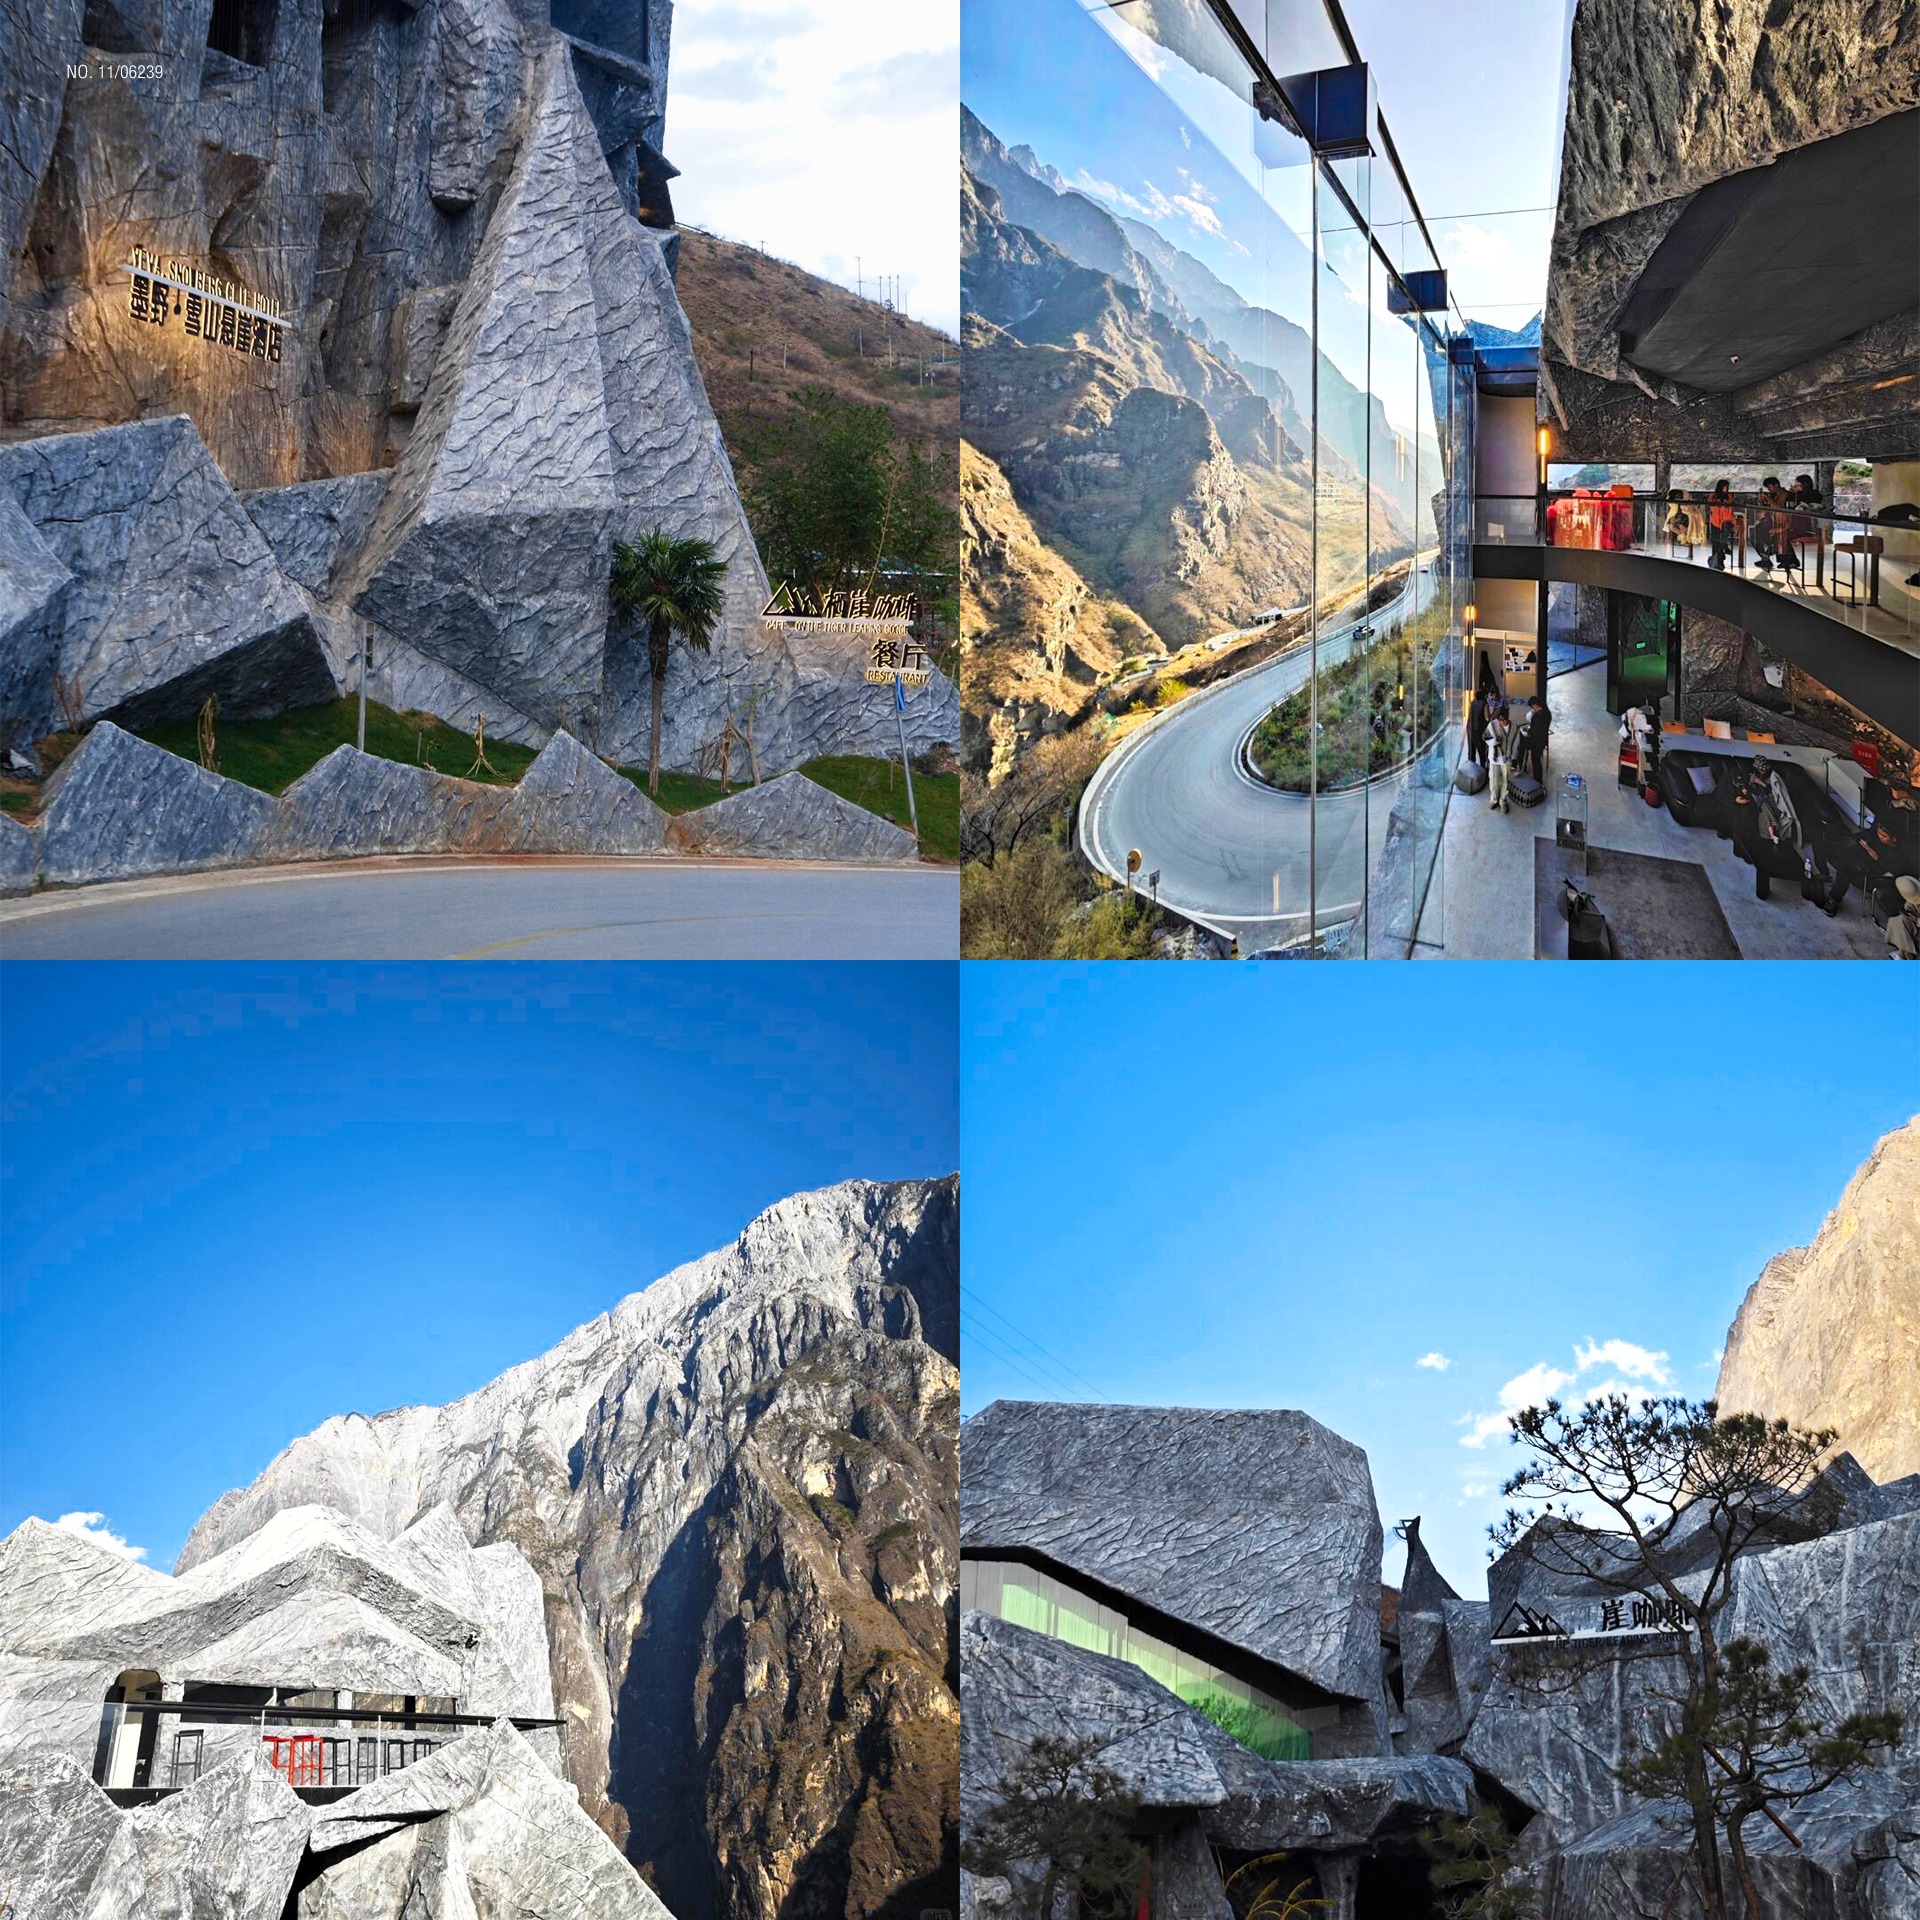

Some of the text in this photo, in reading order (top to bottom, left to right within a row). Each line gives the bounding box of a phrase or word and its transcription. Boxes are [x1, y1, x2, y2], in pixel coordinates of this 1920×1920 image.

[253, 291, 280, 319] HOTEL
[823, 621, 847, 633] TIGER
[871, 638, 928, 670] 餐厅
[1655, 1631, 1686, 1643] GORG
